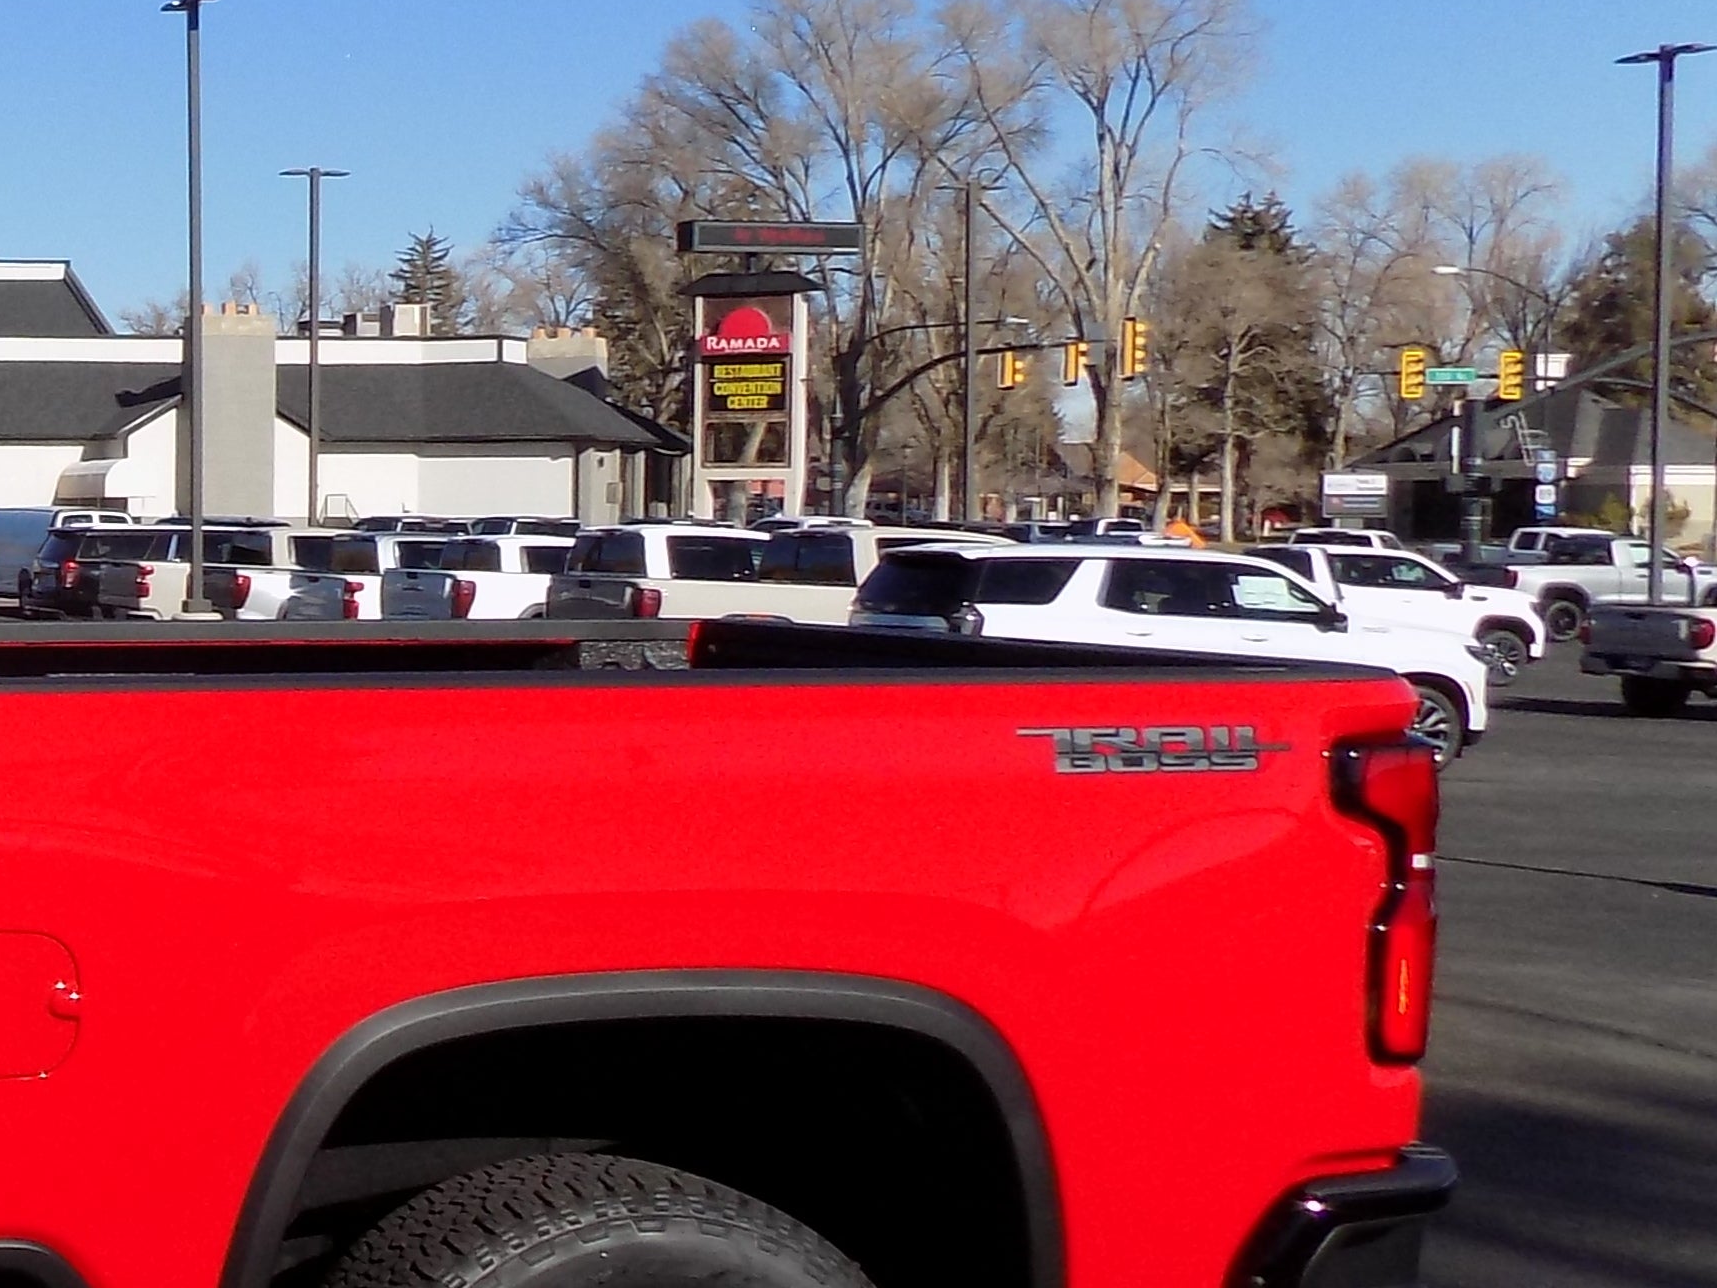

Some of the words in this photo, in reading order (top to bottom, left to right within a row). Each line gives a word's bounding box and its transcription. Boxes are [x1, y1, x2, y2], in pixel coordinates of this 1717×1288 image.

[706, 336, 781, 350] RAMADA
[1016, 725, 1292, 752] TRAIL
[1054, 751, 1259, 774] BOSS
